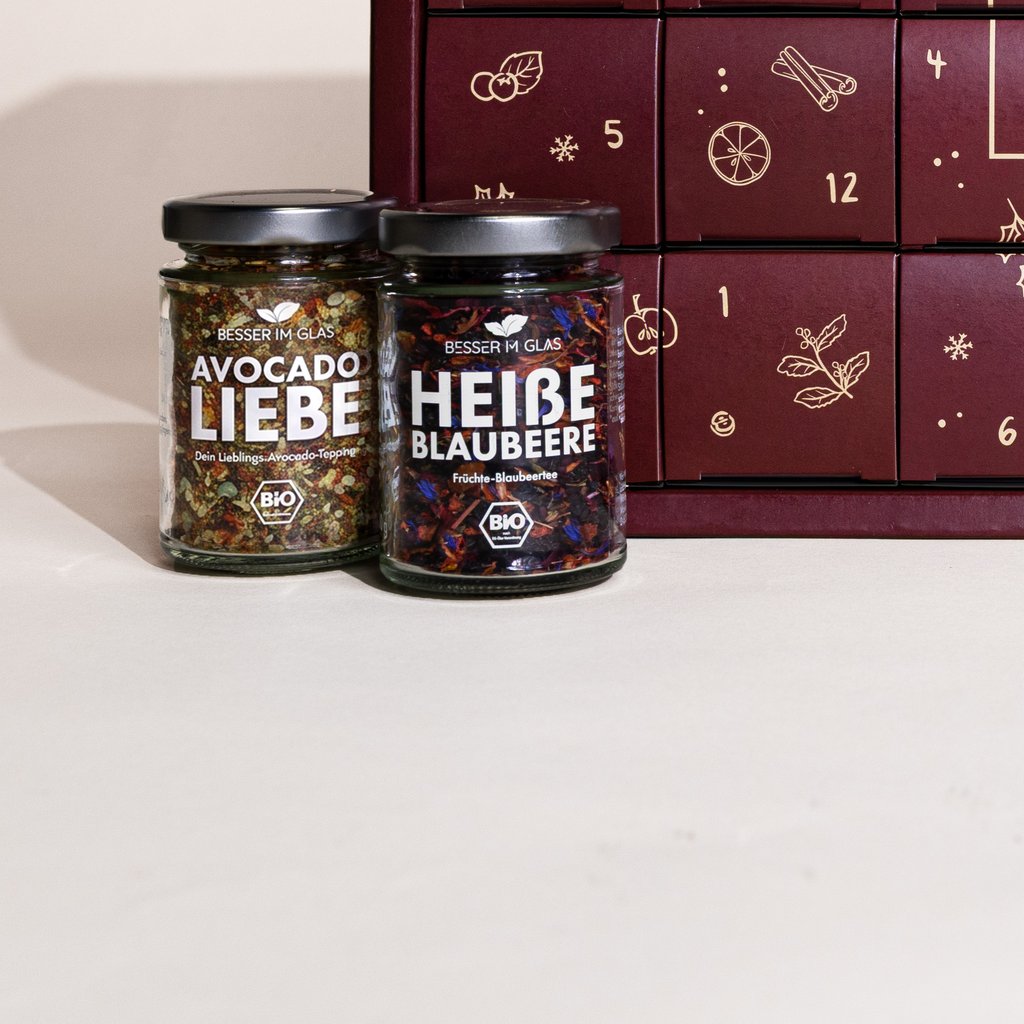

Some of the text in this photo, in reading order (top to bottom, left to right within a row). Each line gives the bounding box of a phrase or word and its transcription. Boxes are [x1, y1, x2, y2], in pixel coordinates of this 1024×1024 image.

[926, 48, 948, 80] 4
[604, 119, 624, 149] 5
[826, 171, 859, 204] 12
[718, 285, 729, 318] 1
[217, 326, 335, 341] BESSER IM GLAS
[445, 340, 501, 354] BESSER
[524, 337, 562, 352] GLAS
[190, 351, 360, 384] AVOCADO
[190, 380, 360, 443] LIEBE
[411, 423, 596, 462] BLAUBEERE
[998, 416, 1017, 446] 6
[195, 451, 216, 462] Dein
[452, 471, 558, 484] Früchte-Blaubeertee
